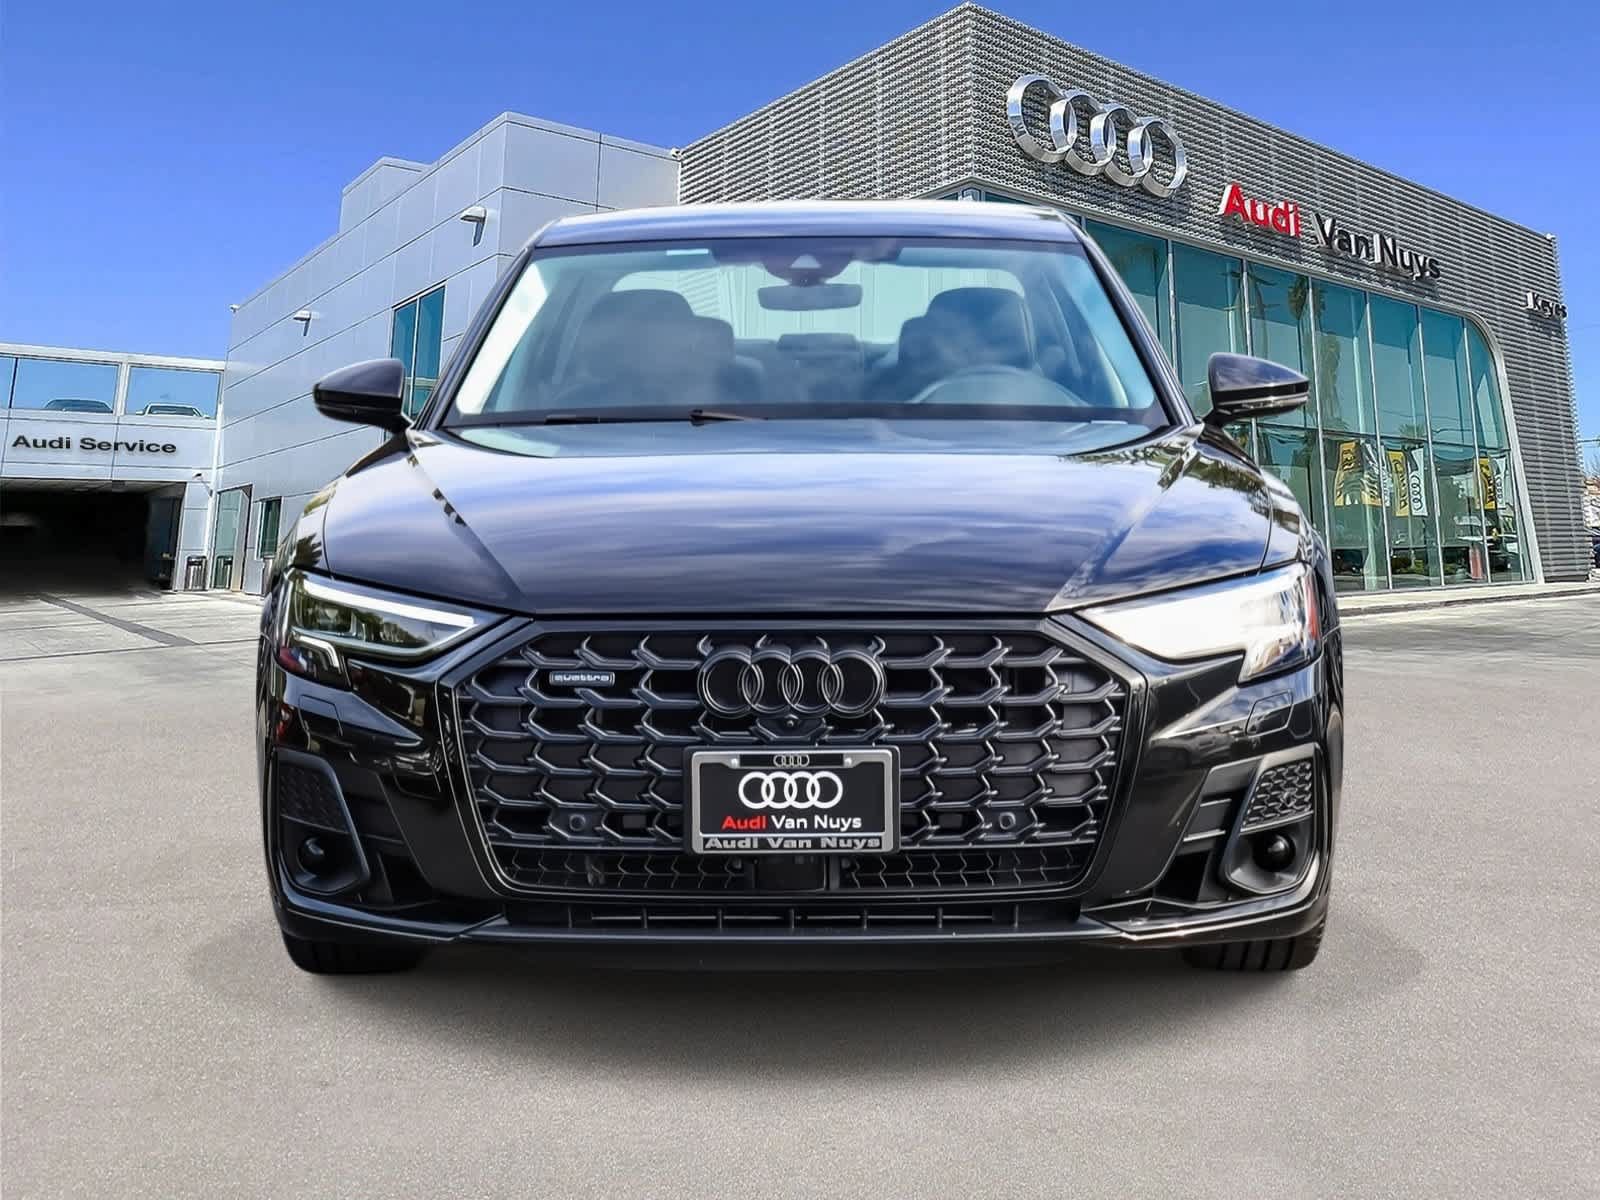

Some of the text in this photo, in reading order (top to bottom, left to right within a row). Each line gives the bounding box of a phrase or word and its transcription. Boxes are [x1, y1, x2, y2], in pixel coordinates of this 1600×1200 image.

[1217, 182, 1440, 280] Audi Van Nuys
[12, 435, 177, 454] Audi Service
[554, 674, 610, 683] quattro
[721, 815, 862, 832] Audi Van Nuys
[705, 837, 881, 850] Audi Van Nuys
